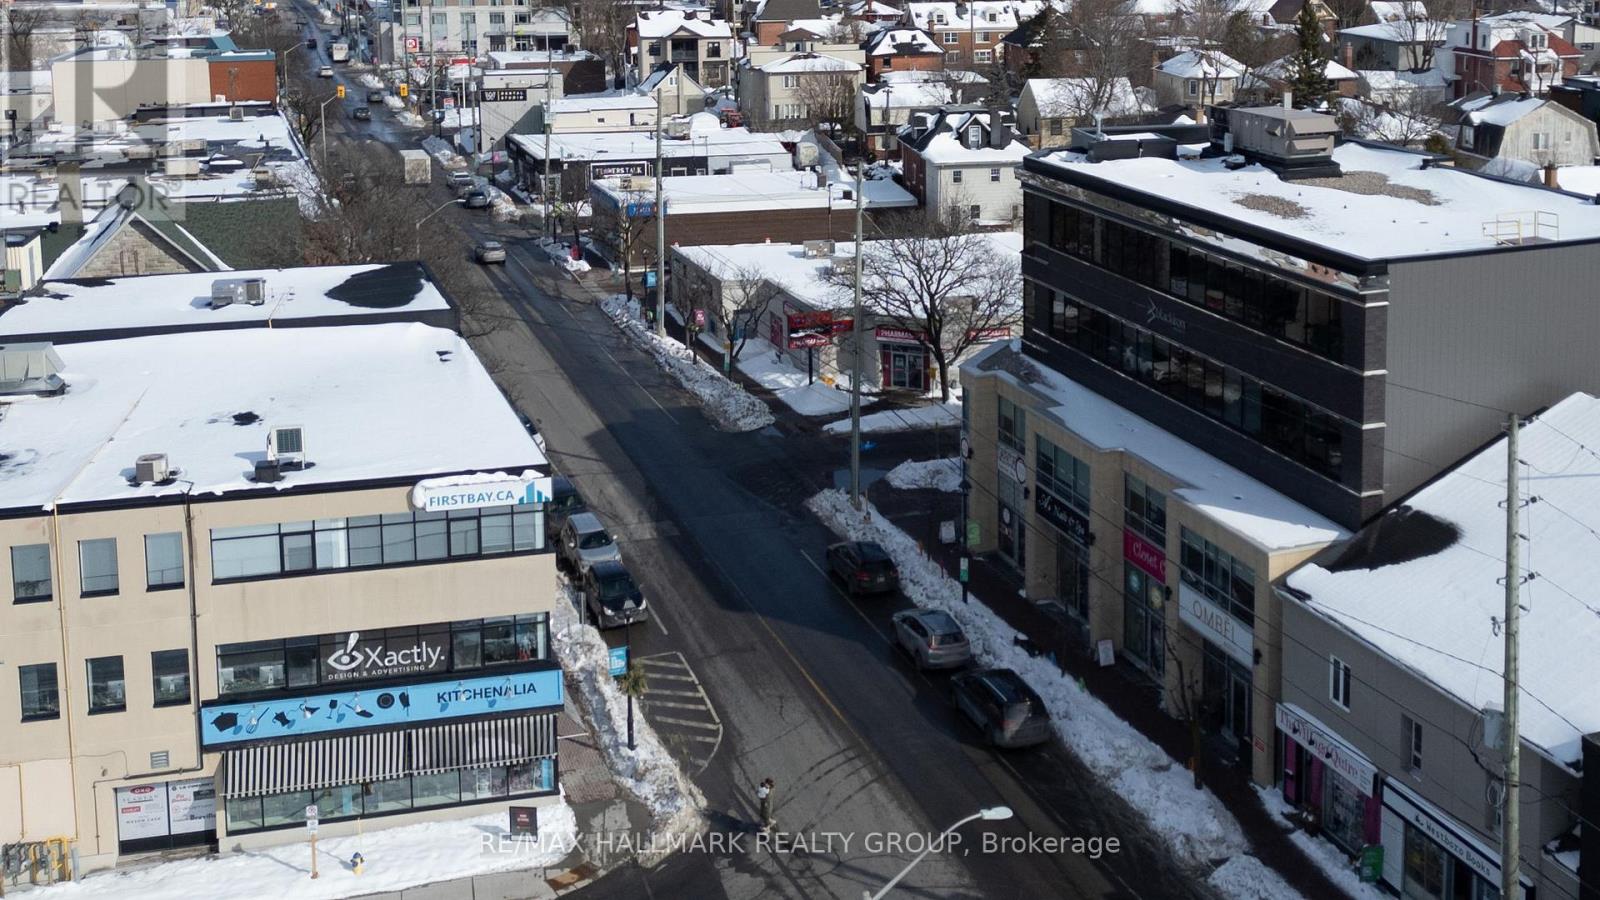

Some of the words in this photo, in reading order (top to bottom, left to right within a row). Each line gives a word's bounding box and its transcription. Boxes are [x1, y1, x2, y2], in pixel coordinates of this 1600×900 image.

[429, 490, 514, 507] FIRSTBAY.CA
[328, 671, 360, 681] DESIGN
[362, 669, 369, 677] &
[371, 664, 426, 676] ADVERTISING
[437, 682, 537, 704] KITCHENALIA
